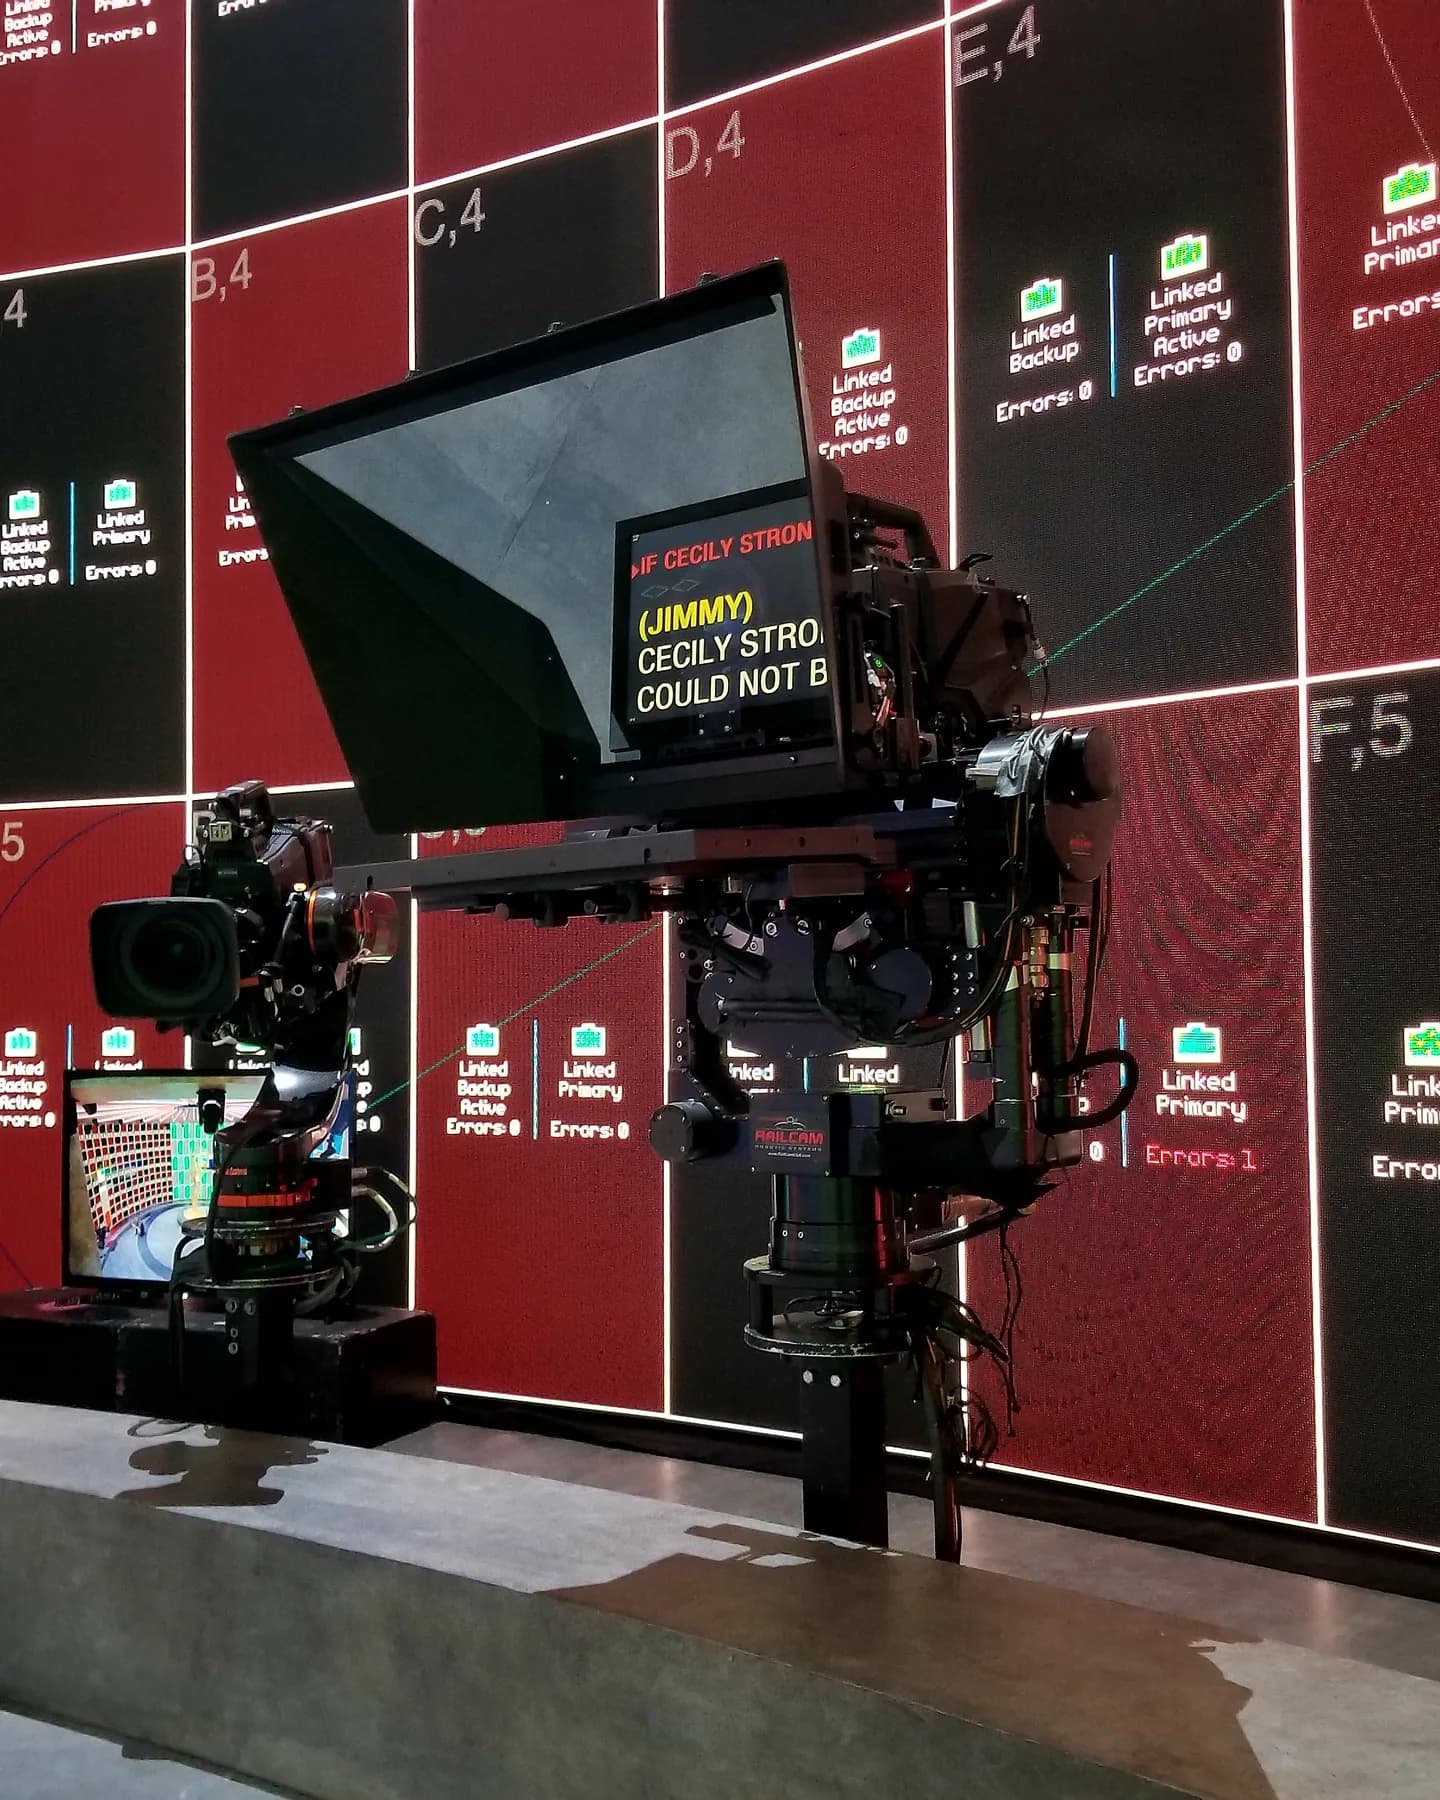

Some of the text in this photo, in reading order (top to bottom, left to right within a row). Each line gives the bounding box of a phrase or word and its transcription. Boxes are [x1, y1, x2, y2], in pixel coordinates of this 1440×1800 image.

[4, 12, 53, 32] Backup
[7, 29, 49, 48] Active
[87, 20, 157, 48] Errors: 0
[51, 40, 61, 55] 0
[951, 5, 1041, 87] E,4
[666, 110, 745, 180] D,4
[414, 187, 486, 247] C,4
[191, 248, 253, 302] B,4
[1150, 272, 1222, 310] Linked
[1144, 297, 1233, 336] Primary
[1011, 314, 1075, 350] Linked
[1153, 325, 1220, 358] Active
[1009, 340, 1079, 374] Backup
[1134, 340, 1243, 387] Errors: 0
[832, 364, 892, 395] Linked
[831, 389, 896, 417] Backup
[996, 380, 1093, 424] Errors: 0
[834, 412, 891, 437] Active
[895, 425, 909, 446] 0
[2, 520, 48, 539] Linked
[97, 510, 145, 529] Linked
[0, 539, 51, 556] Backup
[92, 529, 151, 546] Primary
[640, 520, 813, 576] IF CECILY STRON
[3, 556, 46, 572] Active
[85, 559, 157, 581] Errors: 0
[48, 569, 59, 585] 0
[639, 590, 753, 642] (JIMMY)
[638, 618, 824, 675] CECILY STRO
[637, 657, 828, 713] COULD NOT B
[1311, 692, 1413, 771] F,5
[0, 1060, 44, 1076] Linked
[459, 1061, 508, 1077] Linked
[563, 1061, 616, 1078] Linked
[838, 1063, 899, 1083] Linked
[457, 1079, 511, 1100] Backup
[558, 1080, 623, 1102] Primary
[1162, 1069, 1236, 1092] Linked
[0, 1095, 42, 1110] Active
[460, 1099, 507, 1116] Active
[1155, 1094, 1247, 1123] Primary
[1384, 1101, 1440, 1125] Prim
[45, 1112, 55, 1128] 0
[446, 1118, 521, 1137] Errors: 0
[550, 1120, 630, 1140] Errors: 0
[1089, 1140, 1104, 1162] 0
[1146, 1145, 1257, 1169] Errors: 1
